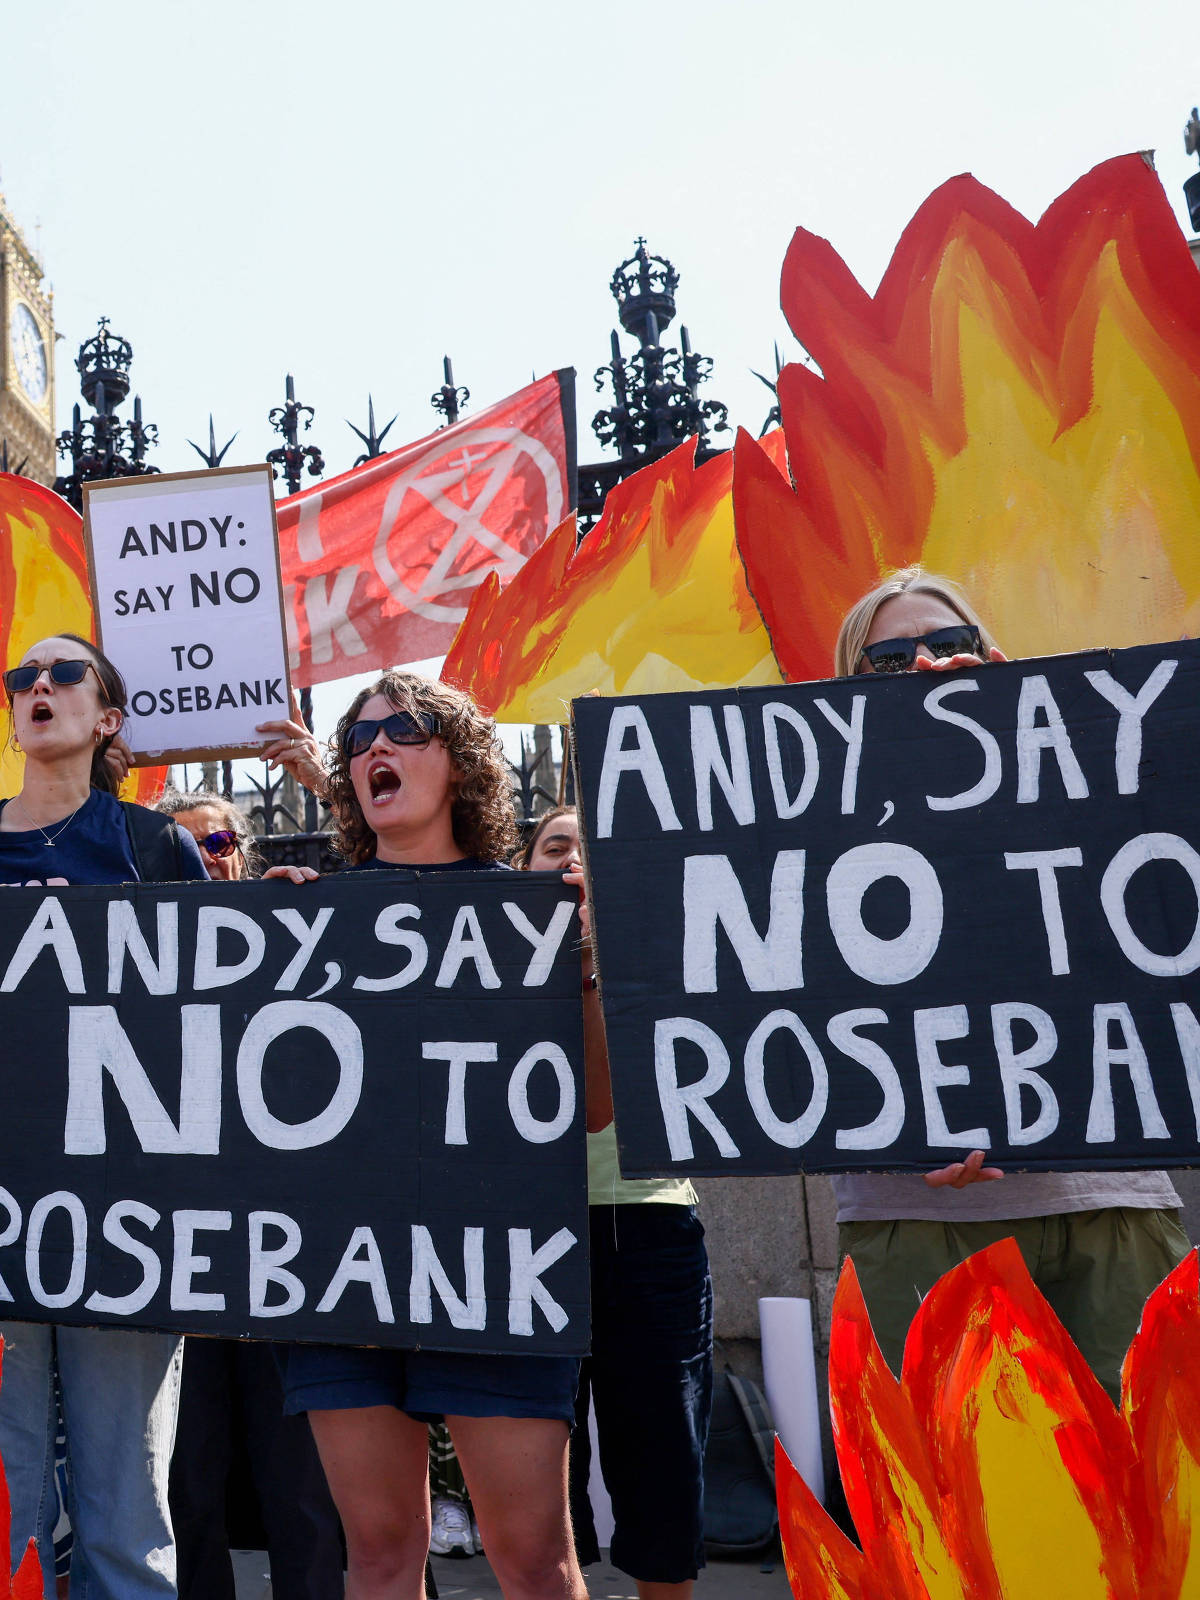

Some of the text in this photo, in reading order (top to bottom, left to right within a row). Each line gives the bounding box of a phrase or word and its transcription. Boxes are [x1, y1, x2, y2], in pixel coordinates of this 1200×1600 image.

[119, 515, 247, 559] ANDY:
[114, 568, 260, 616] SAY NO
[171, 643, 213, 671] TO
[123, 679, 285, 717] OSEBANK
[596, 660, 1178, 838] ANDY, SAY
[0, 896, 341, 999] ANDY,
[353, 901, 575, 991] SAY
[683, 833, 1200, 993] NO TO
[64, 1000, 576, 1156] NO TO
